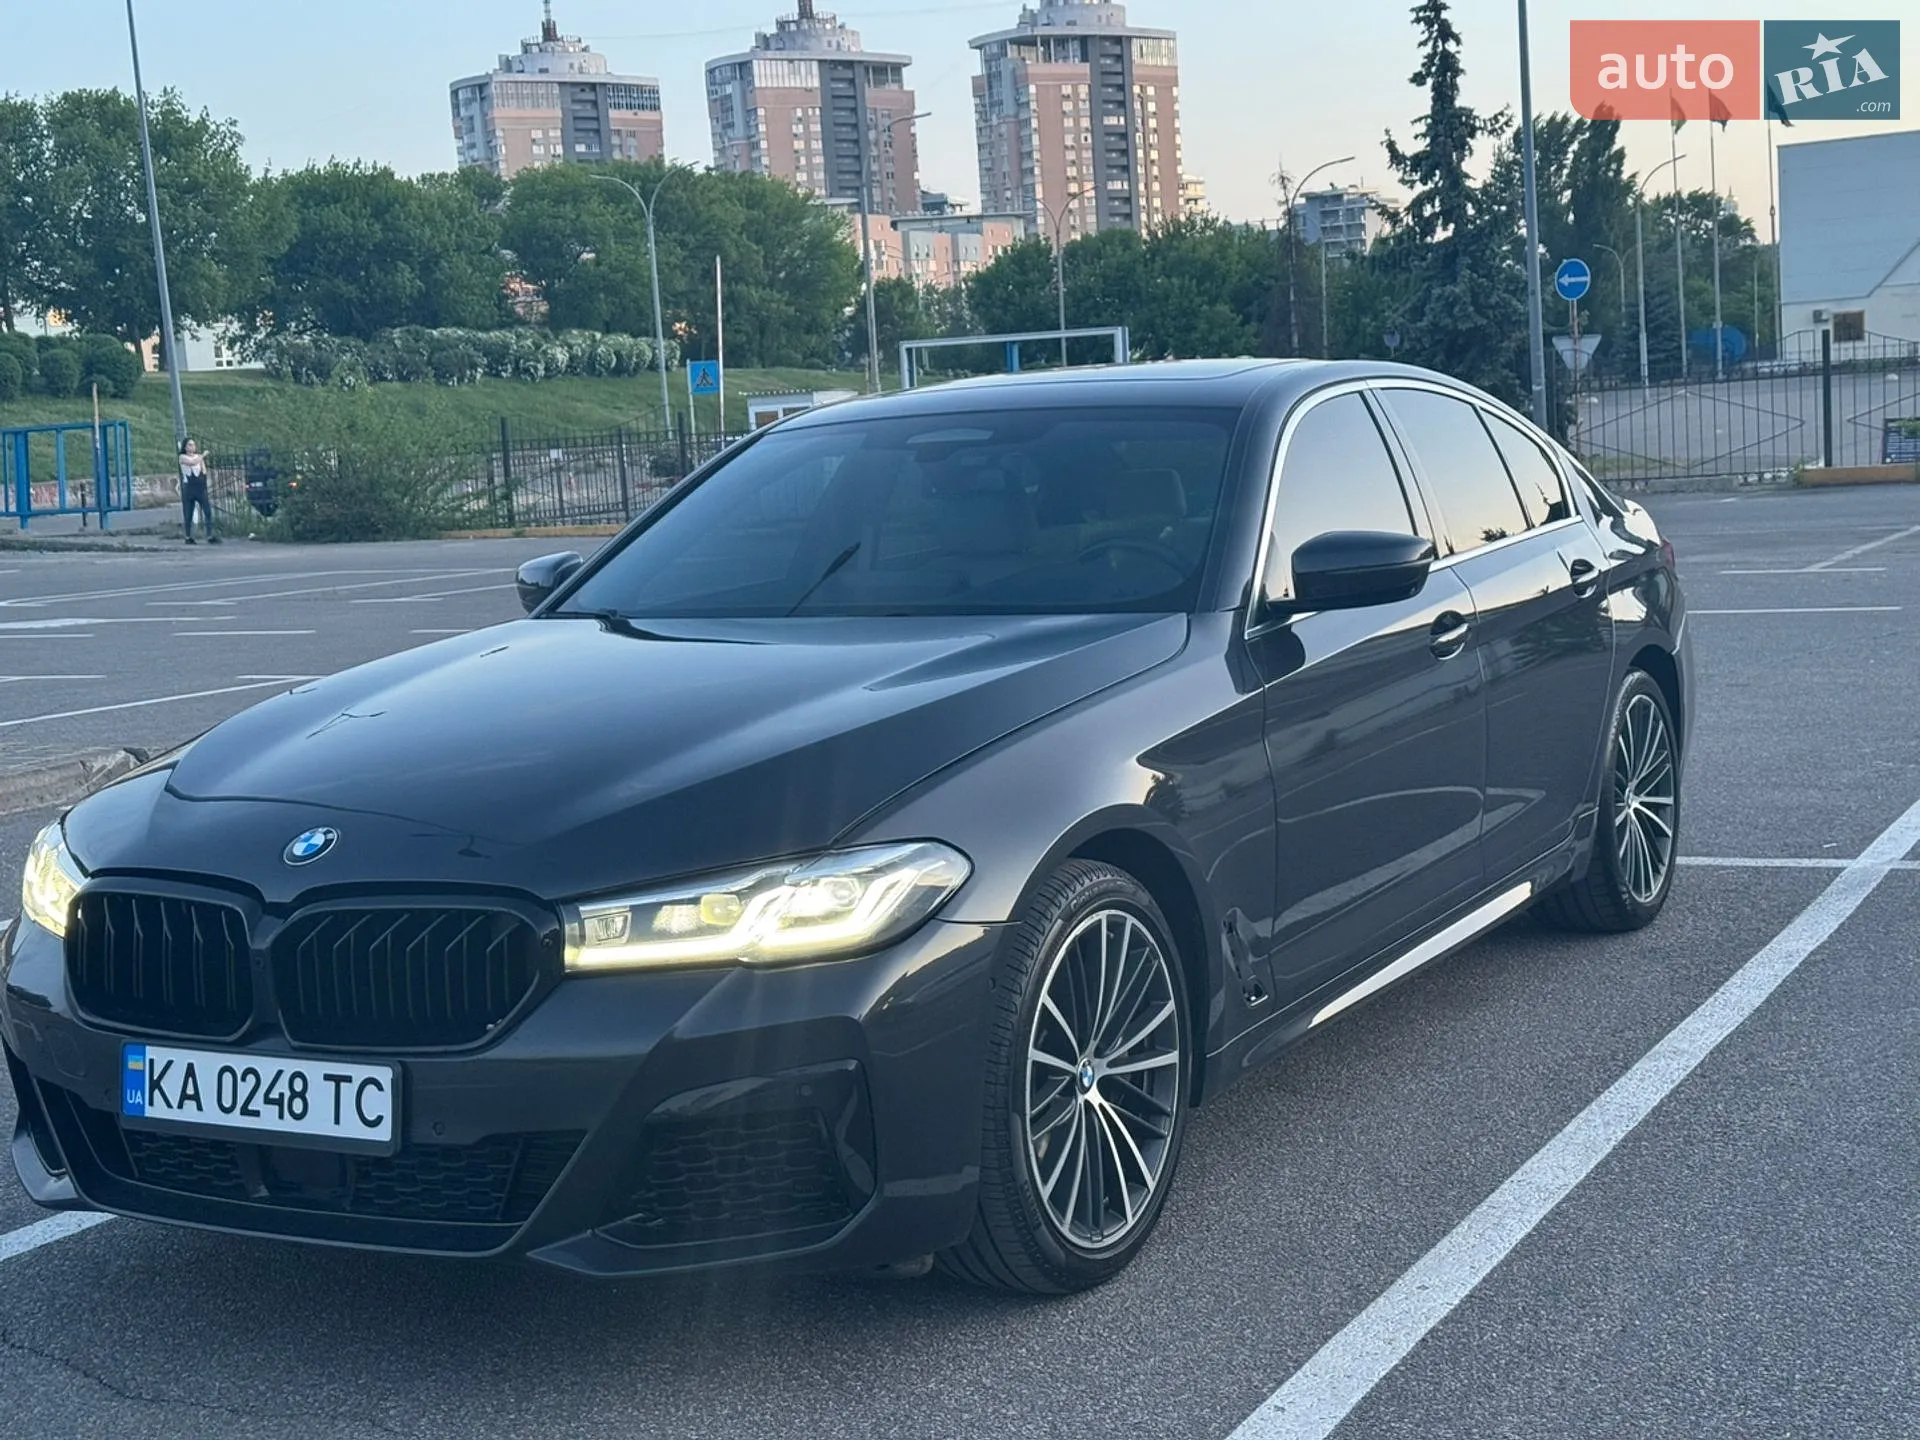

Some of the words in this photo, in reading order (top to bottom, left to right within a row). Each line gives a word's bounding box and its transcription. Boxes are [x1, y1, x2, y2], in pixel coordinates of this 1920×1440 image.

[127, 1088, 143, 1105] UA
[147, 1058, 204, 1112] KA
[217, 1065, 310, 1121] 0248
[323, 1073, 385, 1128] TC
